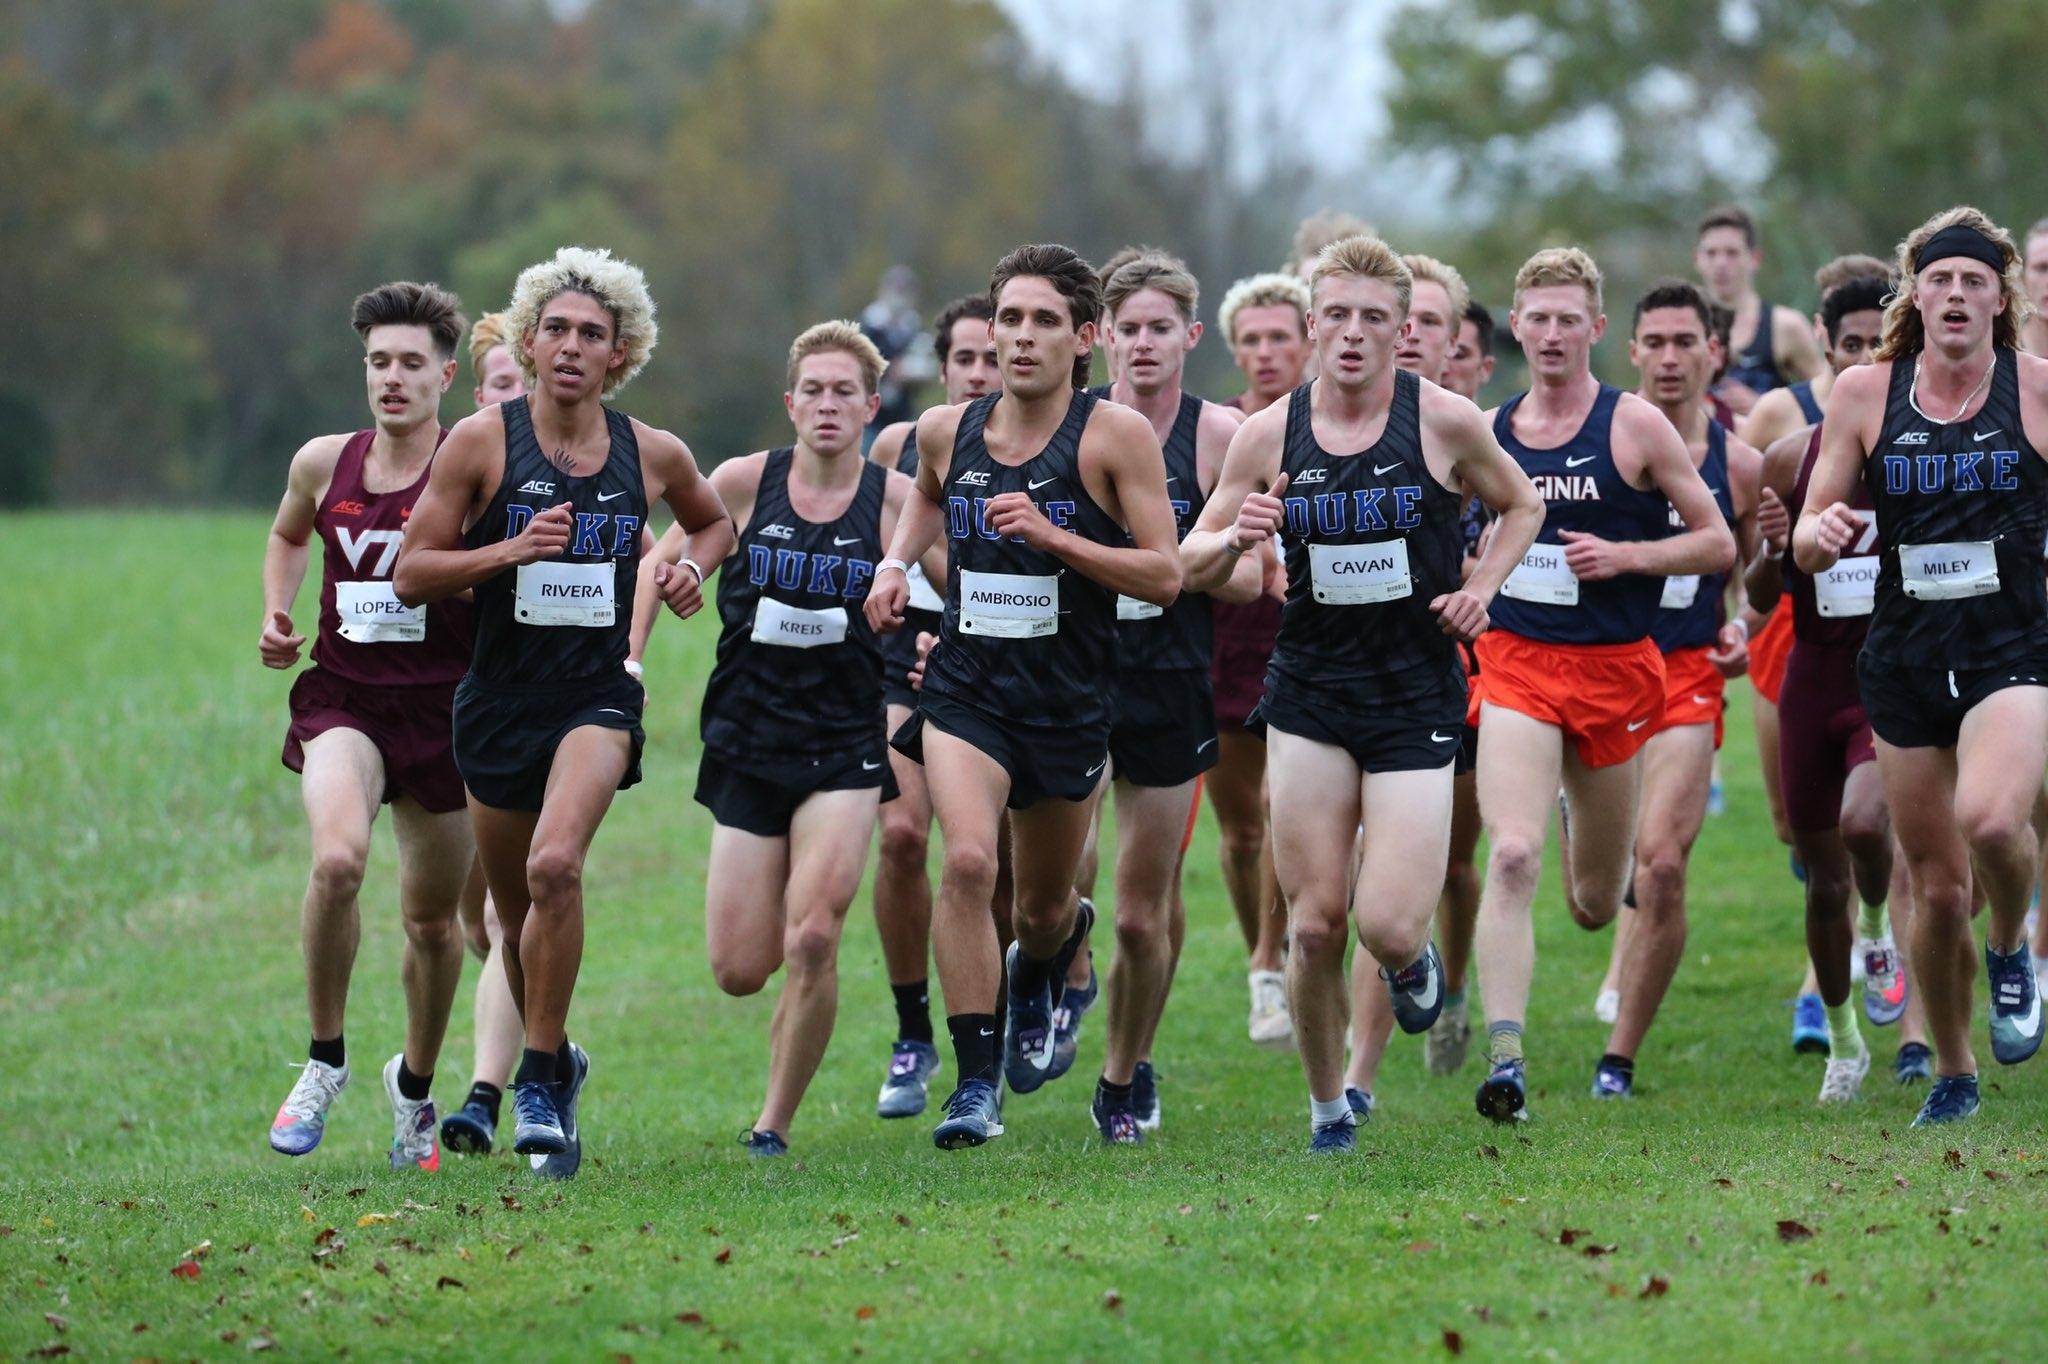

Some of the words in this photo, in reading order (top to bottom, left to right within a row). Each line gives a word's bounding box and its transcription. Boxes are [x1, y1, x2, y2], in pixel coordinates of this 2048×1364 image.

[1892, 432, 1930, 445] ACC
[955, 471, 991, 486] ACC
[1292, 468, 1328, 484] ACC
[1884, 451, 2018, 495] DUKE
[517, 480, 555, 495] ACC
[1530, 475, 1601, 500] GINIA
[331, 500, 364, 515] ACC
[1285, 486, 1423, 538] DUKE
[949, 496, 1076, 543] DUE
[506, 504, 639, 556] DKE
[758, 524, 795, 540] ACC
[335, 526, 405, 577] VT
[748, 544, 873, 599] DUKE
[1332, 557, 1394, 574] CAVAN
[1923, 559, 1971, 576] MILEY
[1828, 568, 1879, 584] SEYOU
[541, 583, 603, 598] RIVERA
[970, 590, 1051, 607] AMBROSIO
[355, 601, 405, 614] LOPEZ
[780, 620, 823, 635] KREIS
